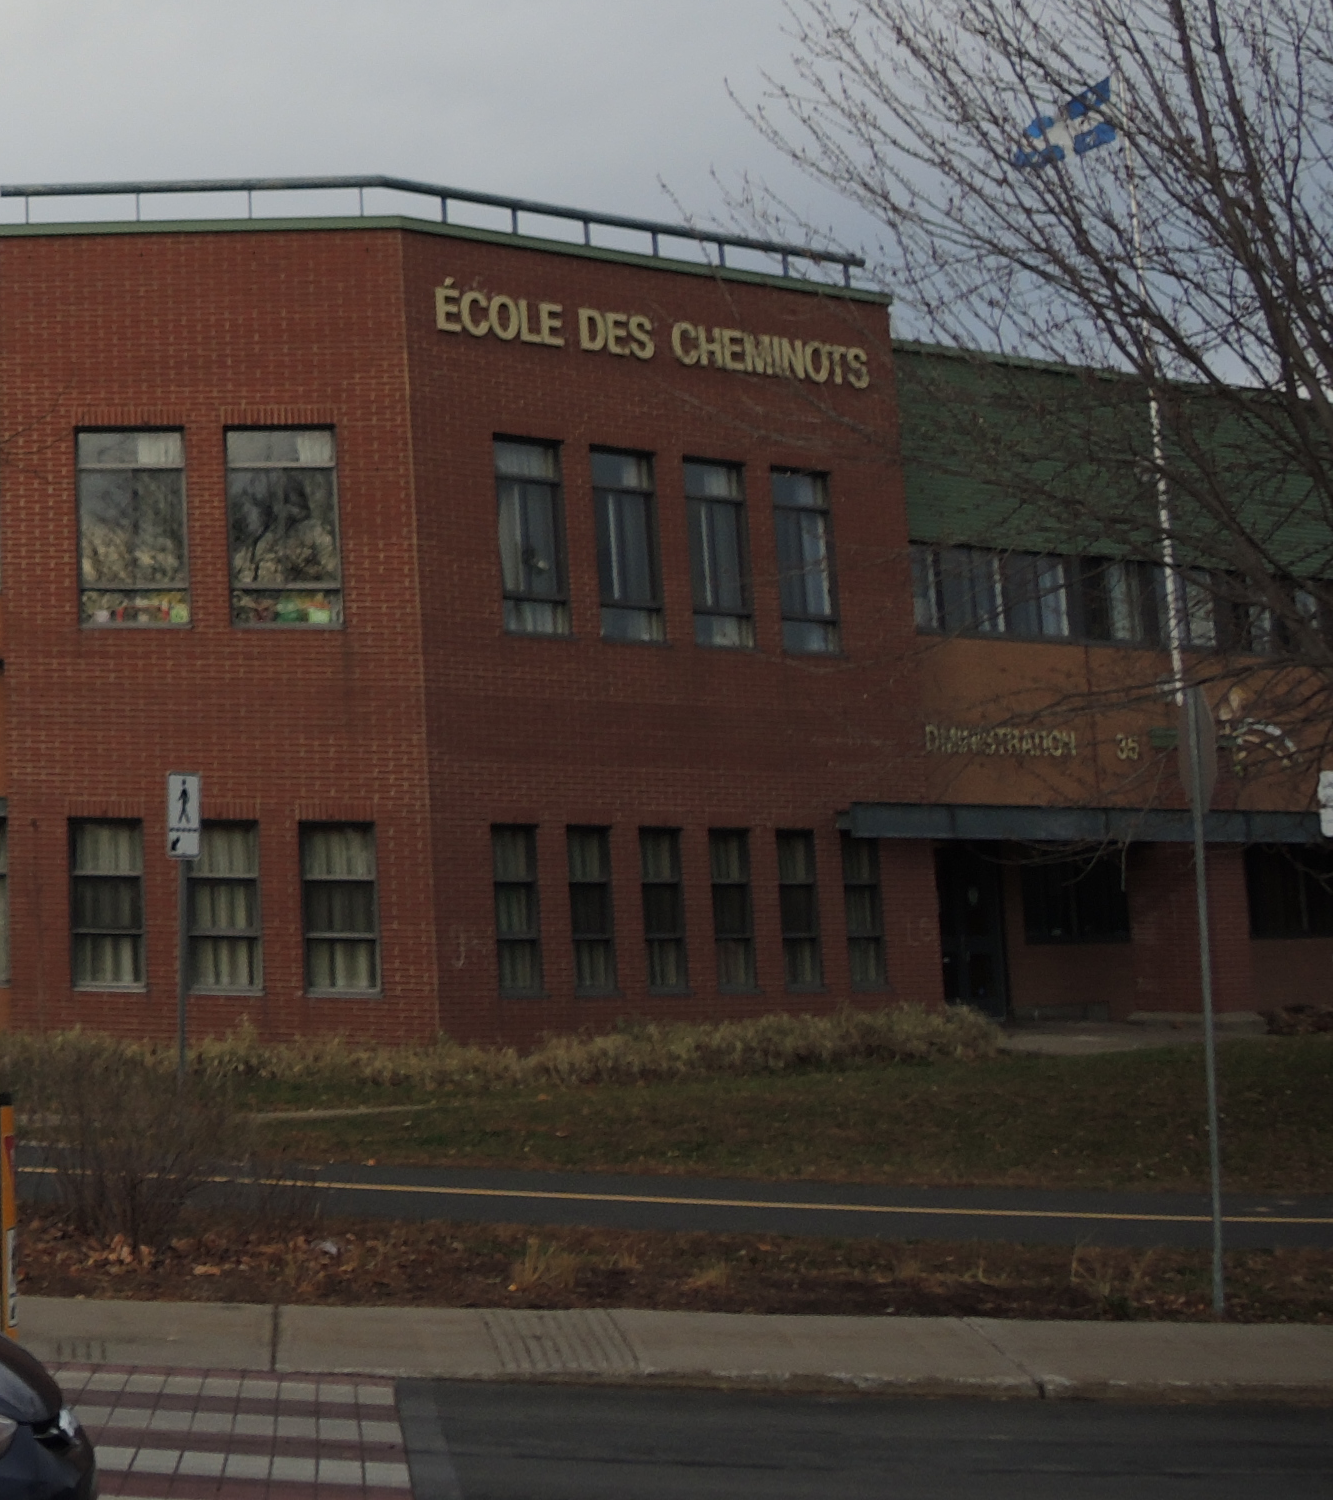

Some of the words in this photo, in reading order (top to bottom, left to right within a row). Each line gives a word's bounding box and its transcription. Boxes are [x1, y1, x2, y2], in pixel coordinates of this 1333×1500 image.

[435, 277, 564, 348] ÉCOLE
[578, 307, 655, 361] DES
[671, 321, 870, 390] CHEMINOTS
[1116, 733, 1140, 760] 35
